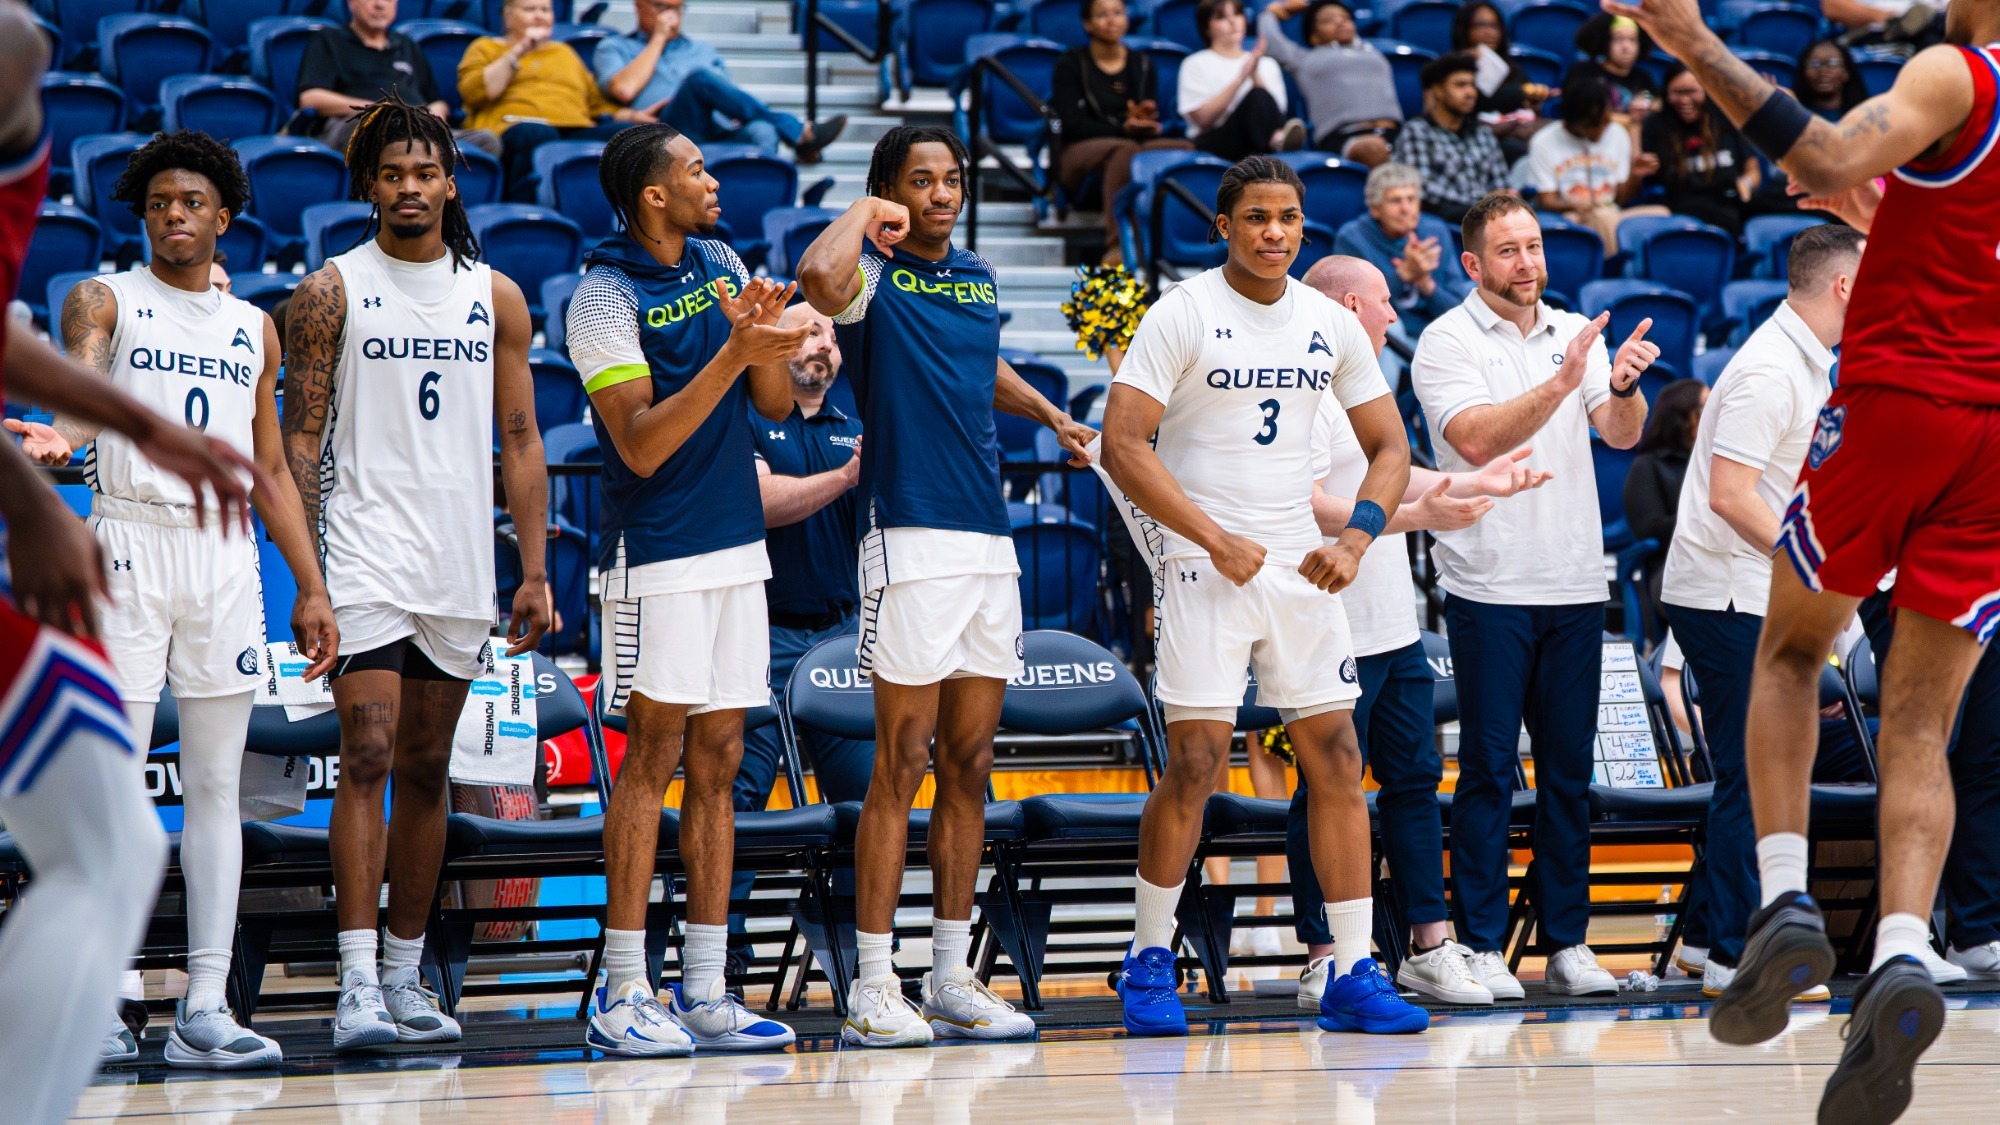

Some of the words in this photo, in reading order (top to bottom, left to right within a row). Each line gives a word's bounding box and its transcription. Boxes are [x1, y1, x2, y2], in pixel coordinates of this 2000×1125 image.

[892, 269, 996, 304] QUEENS
[129, 347, 252, 388] QUEENS
[362, 337, 489, 363] QUEENS
[418, 370, 443, 421] 6
[1206, 367, 1332, 391] QUEENS
[184, 386, 210, 436] 0
[1252, 398, 1281, 446] 3
[511, 663, 520, 716] POWERADE
[1007, 662, 1116, 686] UEENS
[484, 701, 494, 756] POWERADE
